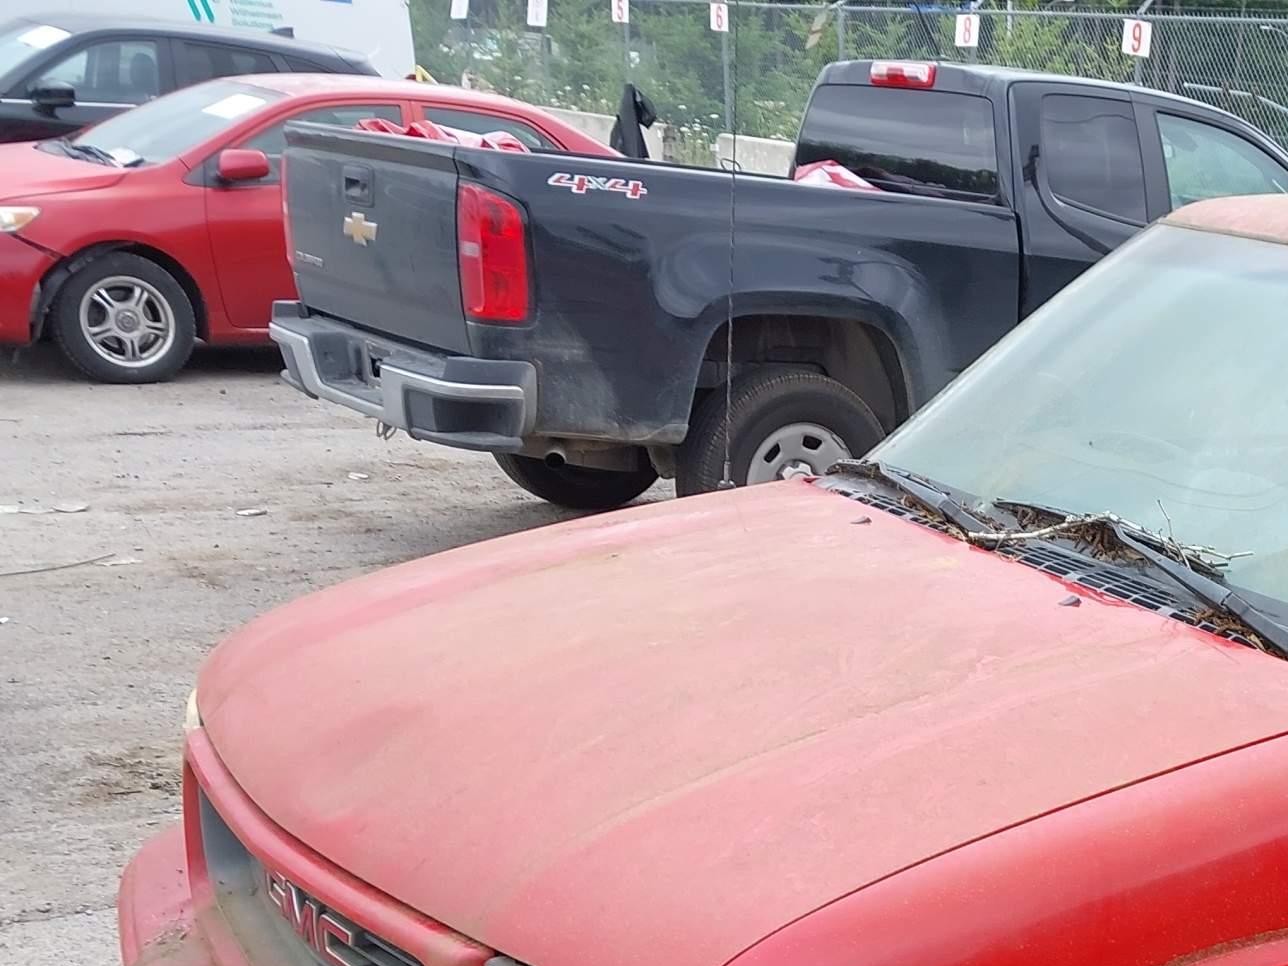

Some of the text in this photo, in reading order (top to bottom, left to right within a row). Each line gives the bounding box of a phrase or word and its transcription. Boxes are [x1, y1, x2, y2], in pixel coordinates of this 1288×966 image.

[715, 5, 724, 29] 6
[963, 16, 972, 44] 8
[1131, 22, 1143, 54] 9
